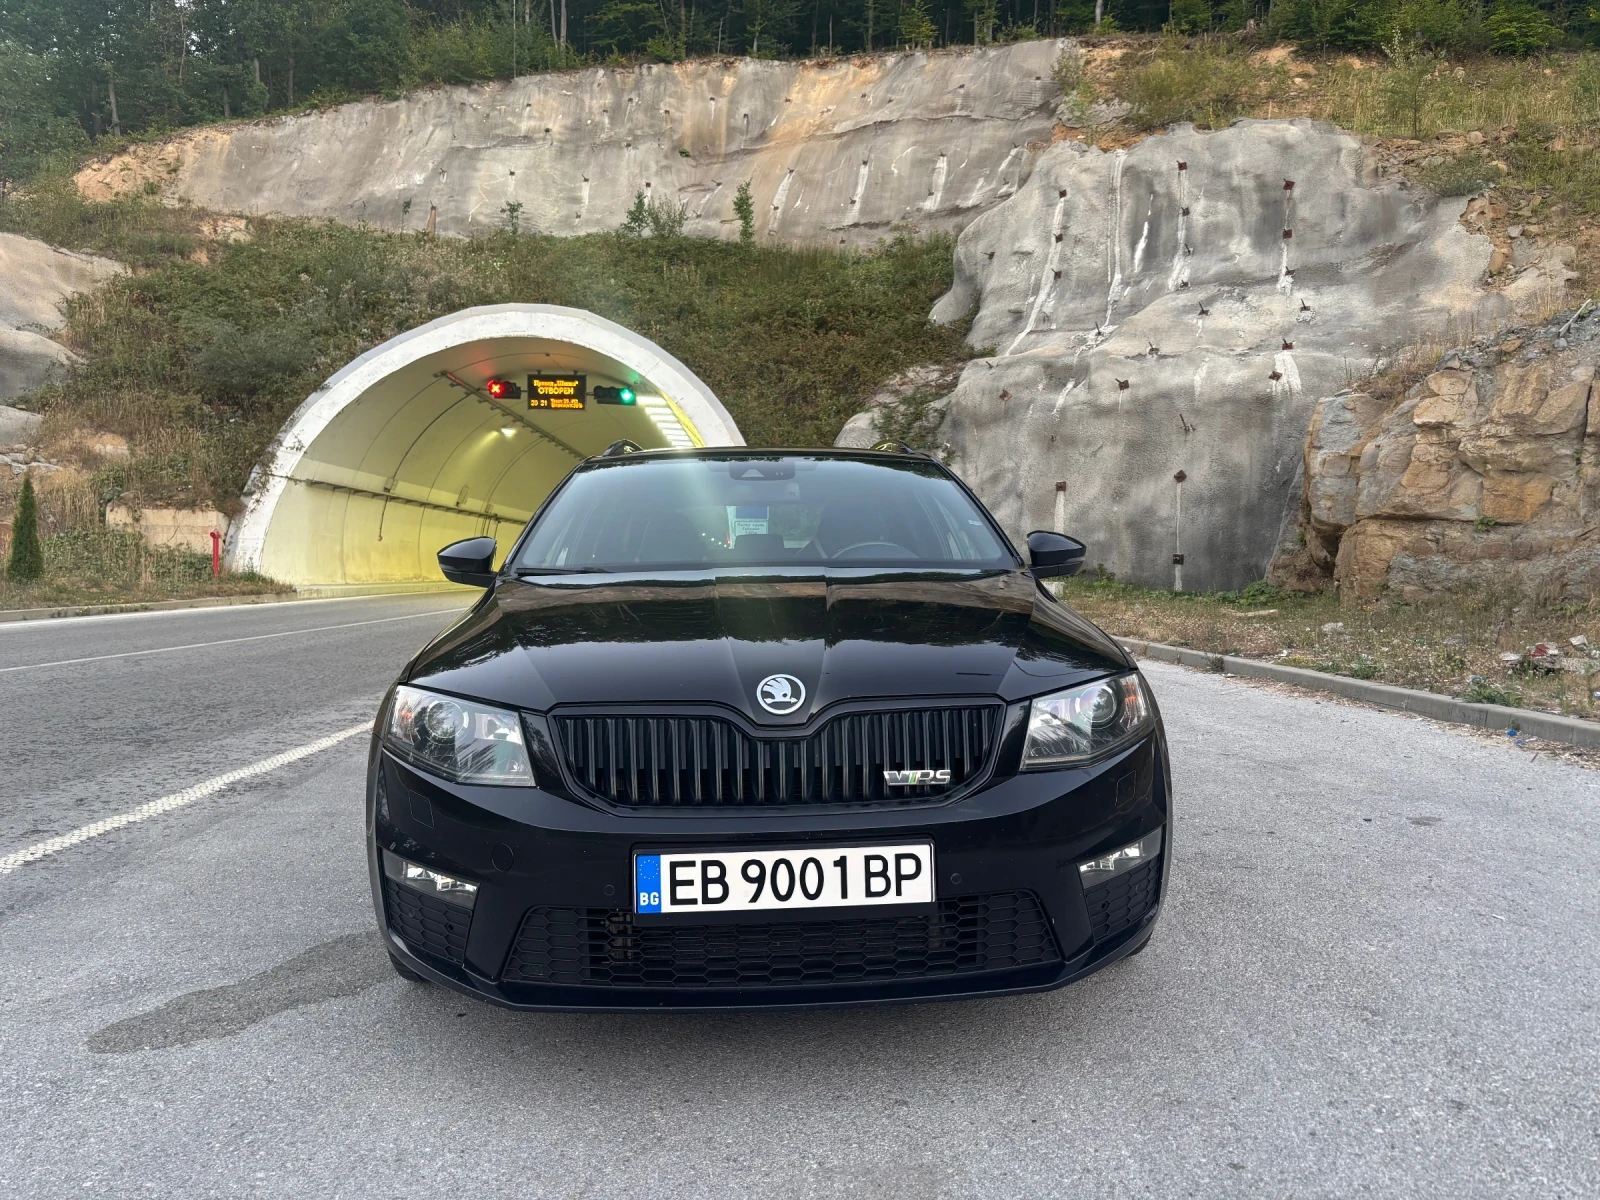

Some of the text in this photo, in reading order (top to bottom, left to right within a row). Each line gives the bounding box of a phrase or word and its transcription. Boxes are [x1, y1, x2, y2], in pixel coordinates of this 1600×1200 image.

[669, 852, 922, 906] EB 9001 BP
[639, 891, 660, 906] BG
